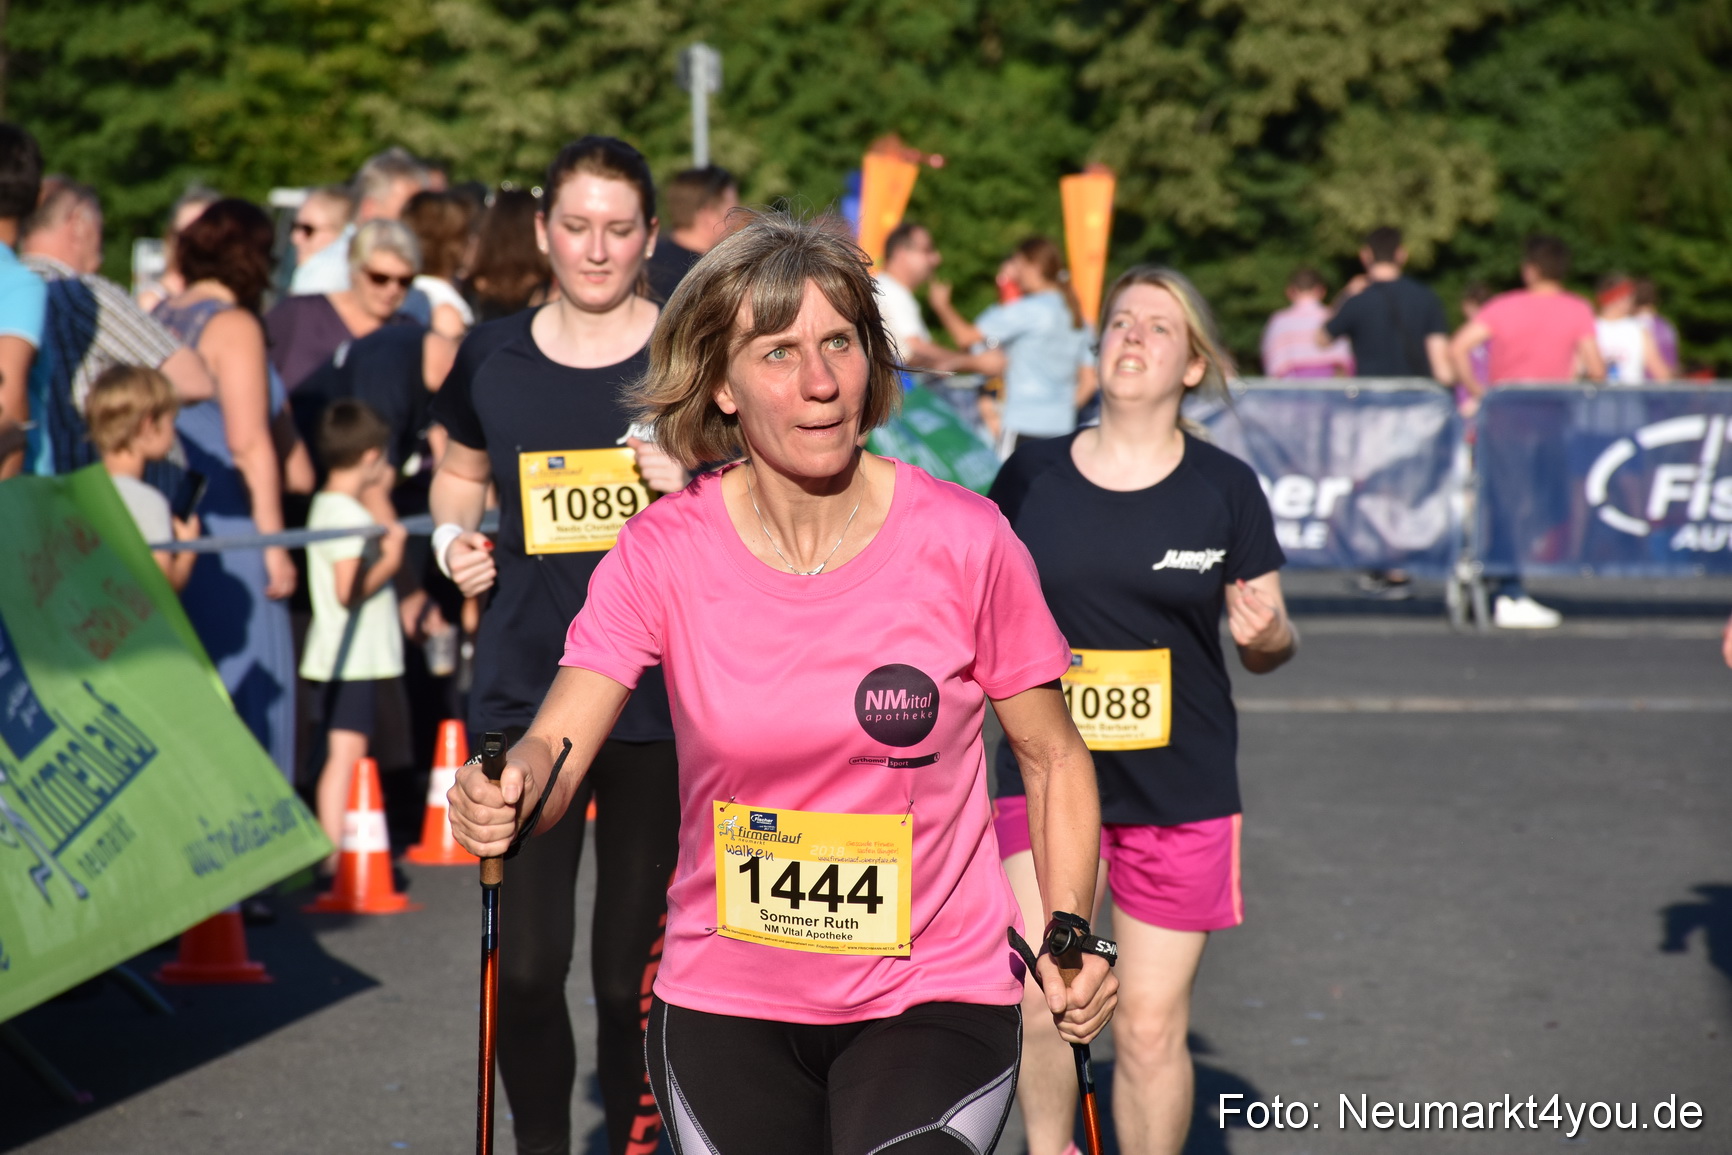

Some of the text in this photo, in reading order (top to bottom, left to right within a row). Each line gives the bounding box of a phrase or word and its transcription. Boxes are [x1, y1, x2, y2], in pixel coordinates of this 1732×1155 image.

[542, 486, 638, 521] 1089
[1258, 473, 1353, 519] er
[1670, 523, 1732, 552] AU
[1064, 686, 1151, 719] 1088
[865, 710, 932, 722] apotheke
[738, 826, 803, 844] firmenlauf
[738, 838, 766, 846] neumarkt
[725, 843, 775, 861] walken
[809, 844, 846, 857] 2018
[739, 856, 884, 914] 1444
[760, 908, 859, 929] Sommer Ruth
[764, 924, 780, 933] NM
[805, 929, 853, 941] Apotheke
